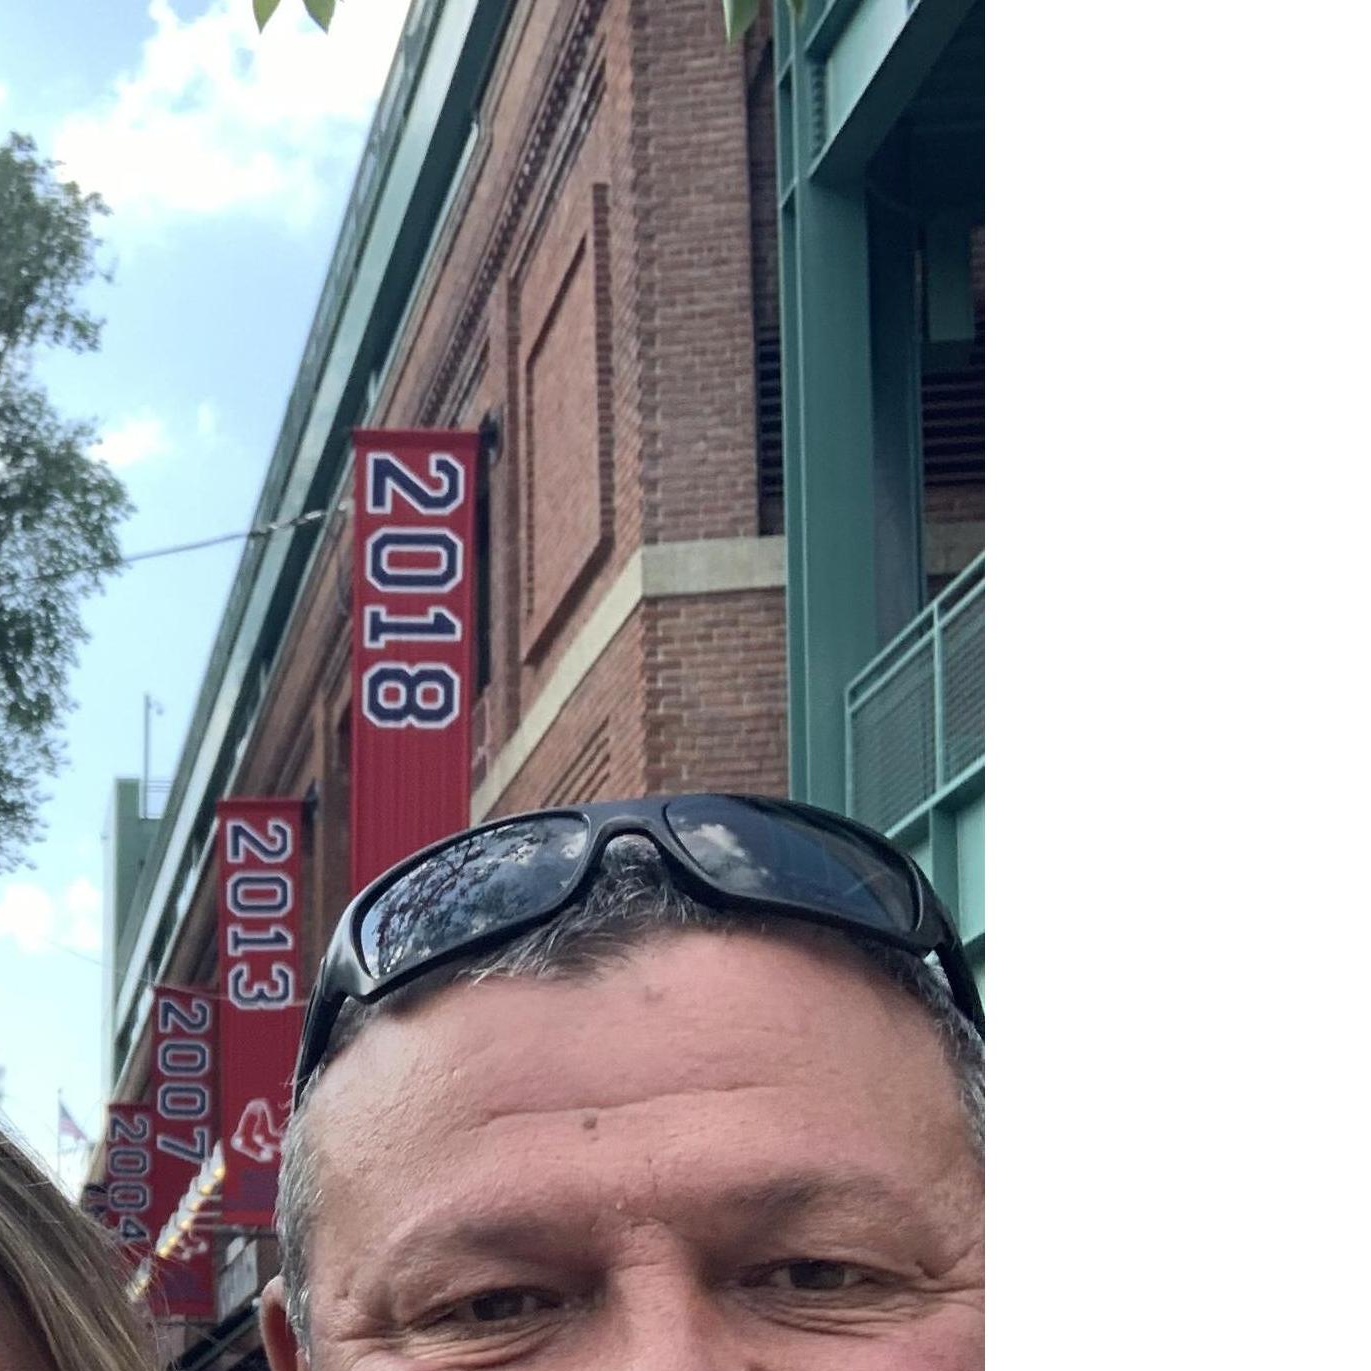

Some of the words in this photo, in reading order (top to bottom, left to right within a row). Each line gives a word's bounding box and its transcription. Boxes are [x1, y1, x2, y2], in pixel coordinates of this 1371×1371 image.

[362, 451, 466, 730] 2018
[227, 817, 294, 1012] 2013
[156, 994, 211, 1165] 2007
[108, 1112, 151, 1241] 2004
